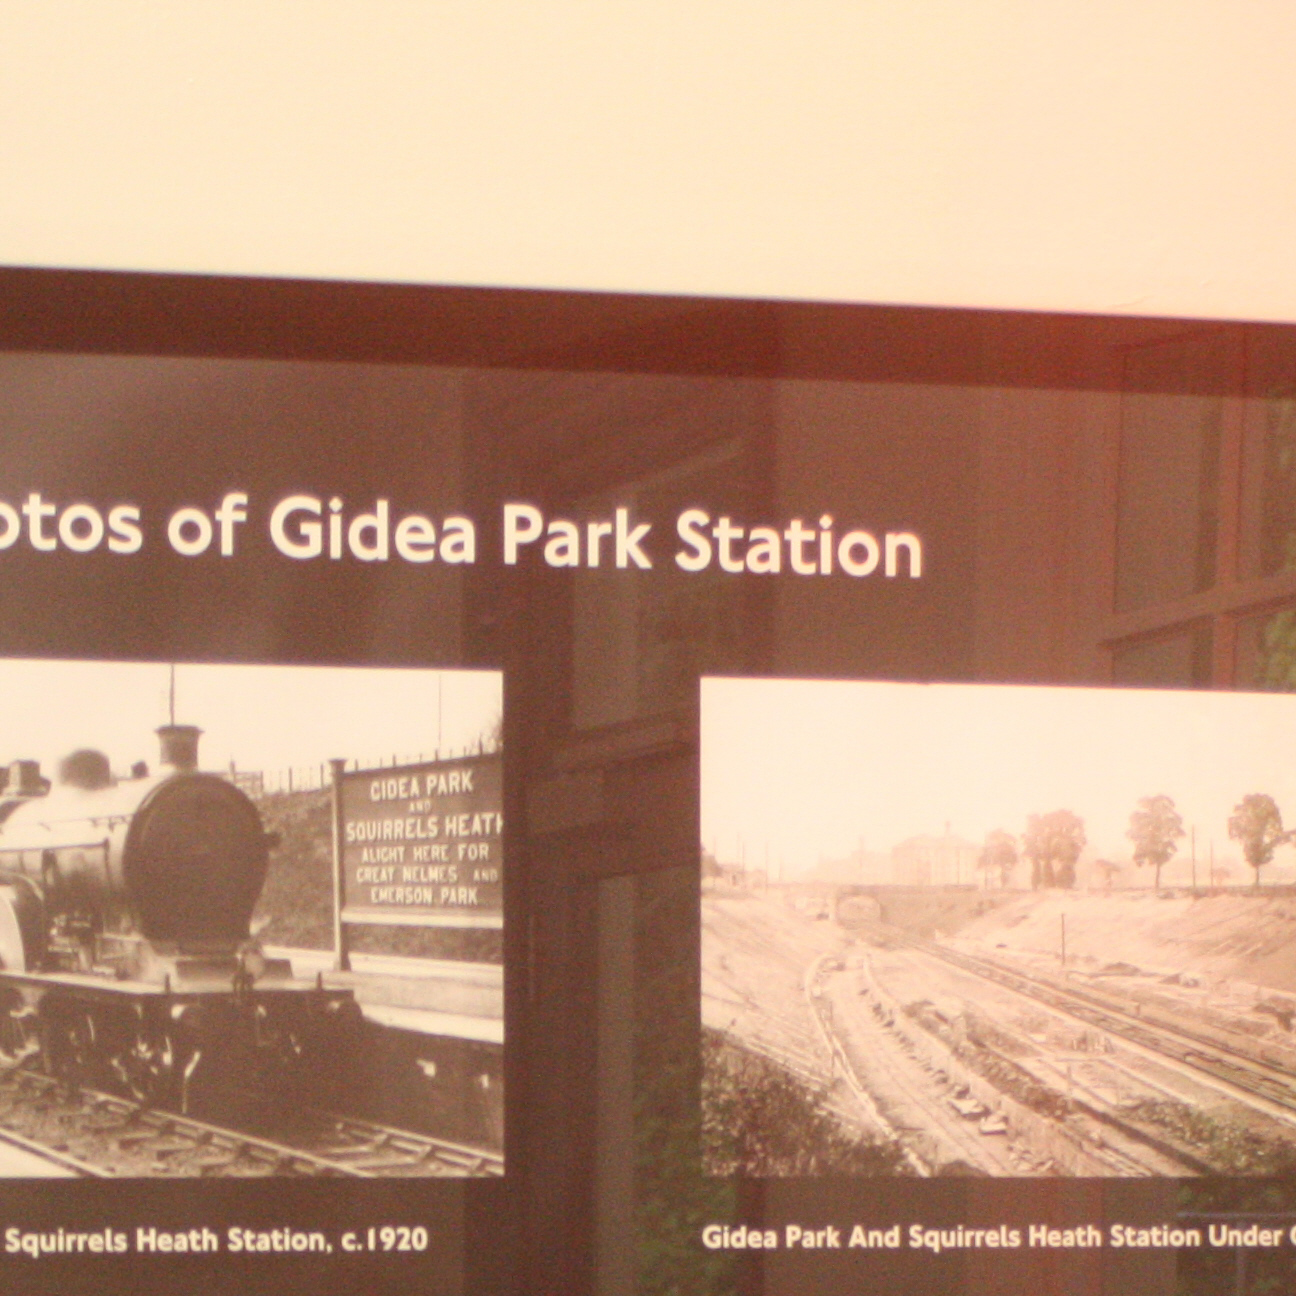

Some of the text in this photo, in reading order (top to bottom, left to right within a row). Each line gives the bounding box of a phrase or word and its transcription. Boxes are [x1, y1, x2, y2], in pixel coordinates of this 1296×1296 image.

[167, 491, 249, 557] of
[269, 494, 476, 564] Gidea
[503, 503, 653, 570] Park
[674, 508, 923, 579] Station
[370, 769, 474, 801] GIDEA PARK
[408, 799, 432, 814] AND
[346, 815, 439, 842] SQUIRRELS
[361, 842, 490, 864] ALIGHT HERE FOR
[356, 865, 499, 883] GREAT NELMES AND
[370, 886, 479, 905] EMERSON PARK
[4, 1227, 128, 1259] Squirrels
[136, 1227, 219, 1253] Heath
[227, 1226, 333, 1255] Station,
[341, 1225, 429, 1252] c.1920
[701, 1224, 778, 1249] Gidea
[785, 1224, 841, 1249] Park
[848, 1224, 901, 1249] And
[908, 1224, 1022, 1254] Squirrels
[1028, 1224, 1103, 1248] Heath
[1110, 1223, 1201, 1248] Station
[1208, 1224, 1284, 1247] Under
